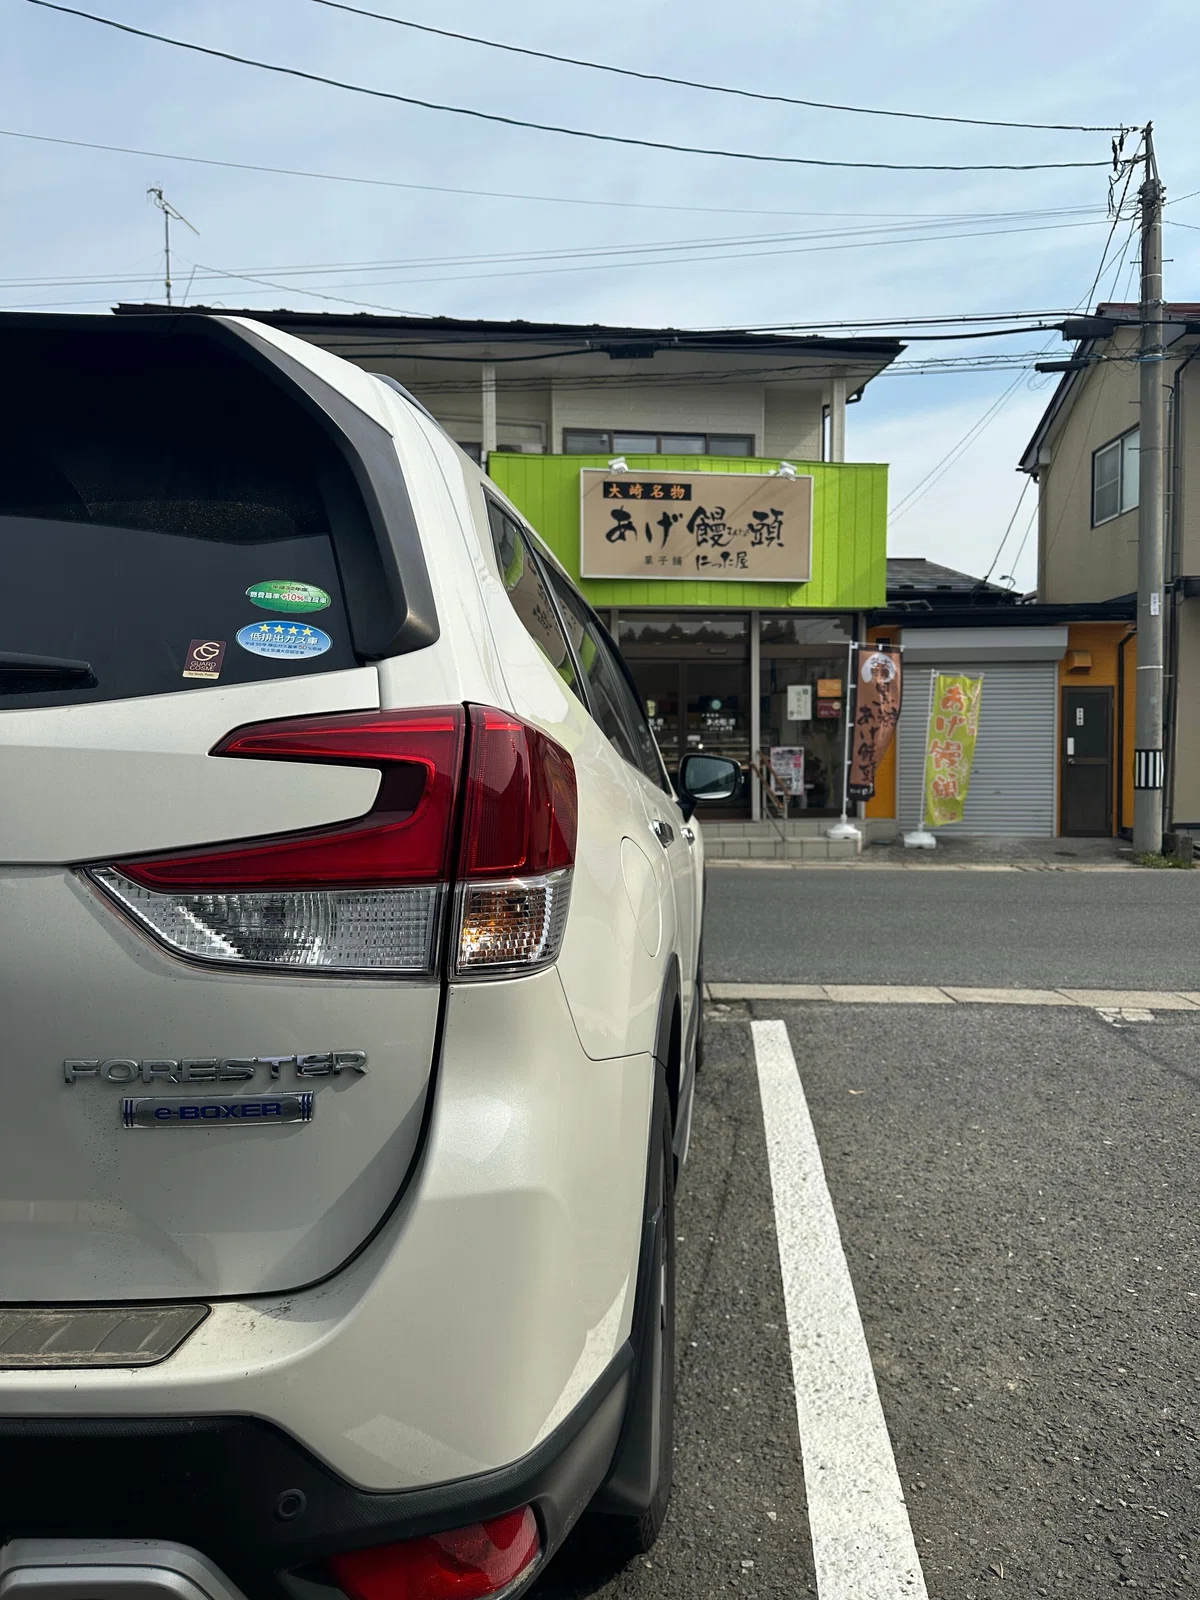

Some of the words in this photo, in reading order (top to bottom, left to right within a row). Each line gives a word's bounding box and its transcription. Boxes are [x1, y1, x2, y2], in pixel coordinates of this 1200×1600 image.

[607, 483, 686, 499] 大崎名物
[605, 505, 785, 548] あげ饅頭
[696, 551, 749, 571] にった屋
[250, 632, 319, 646] 低排出ガス車
[64, 1050, 368, 1084] FORESTER
[154, 1102, 282, 1121] e-BOXER
